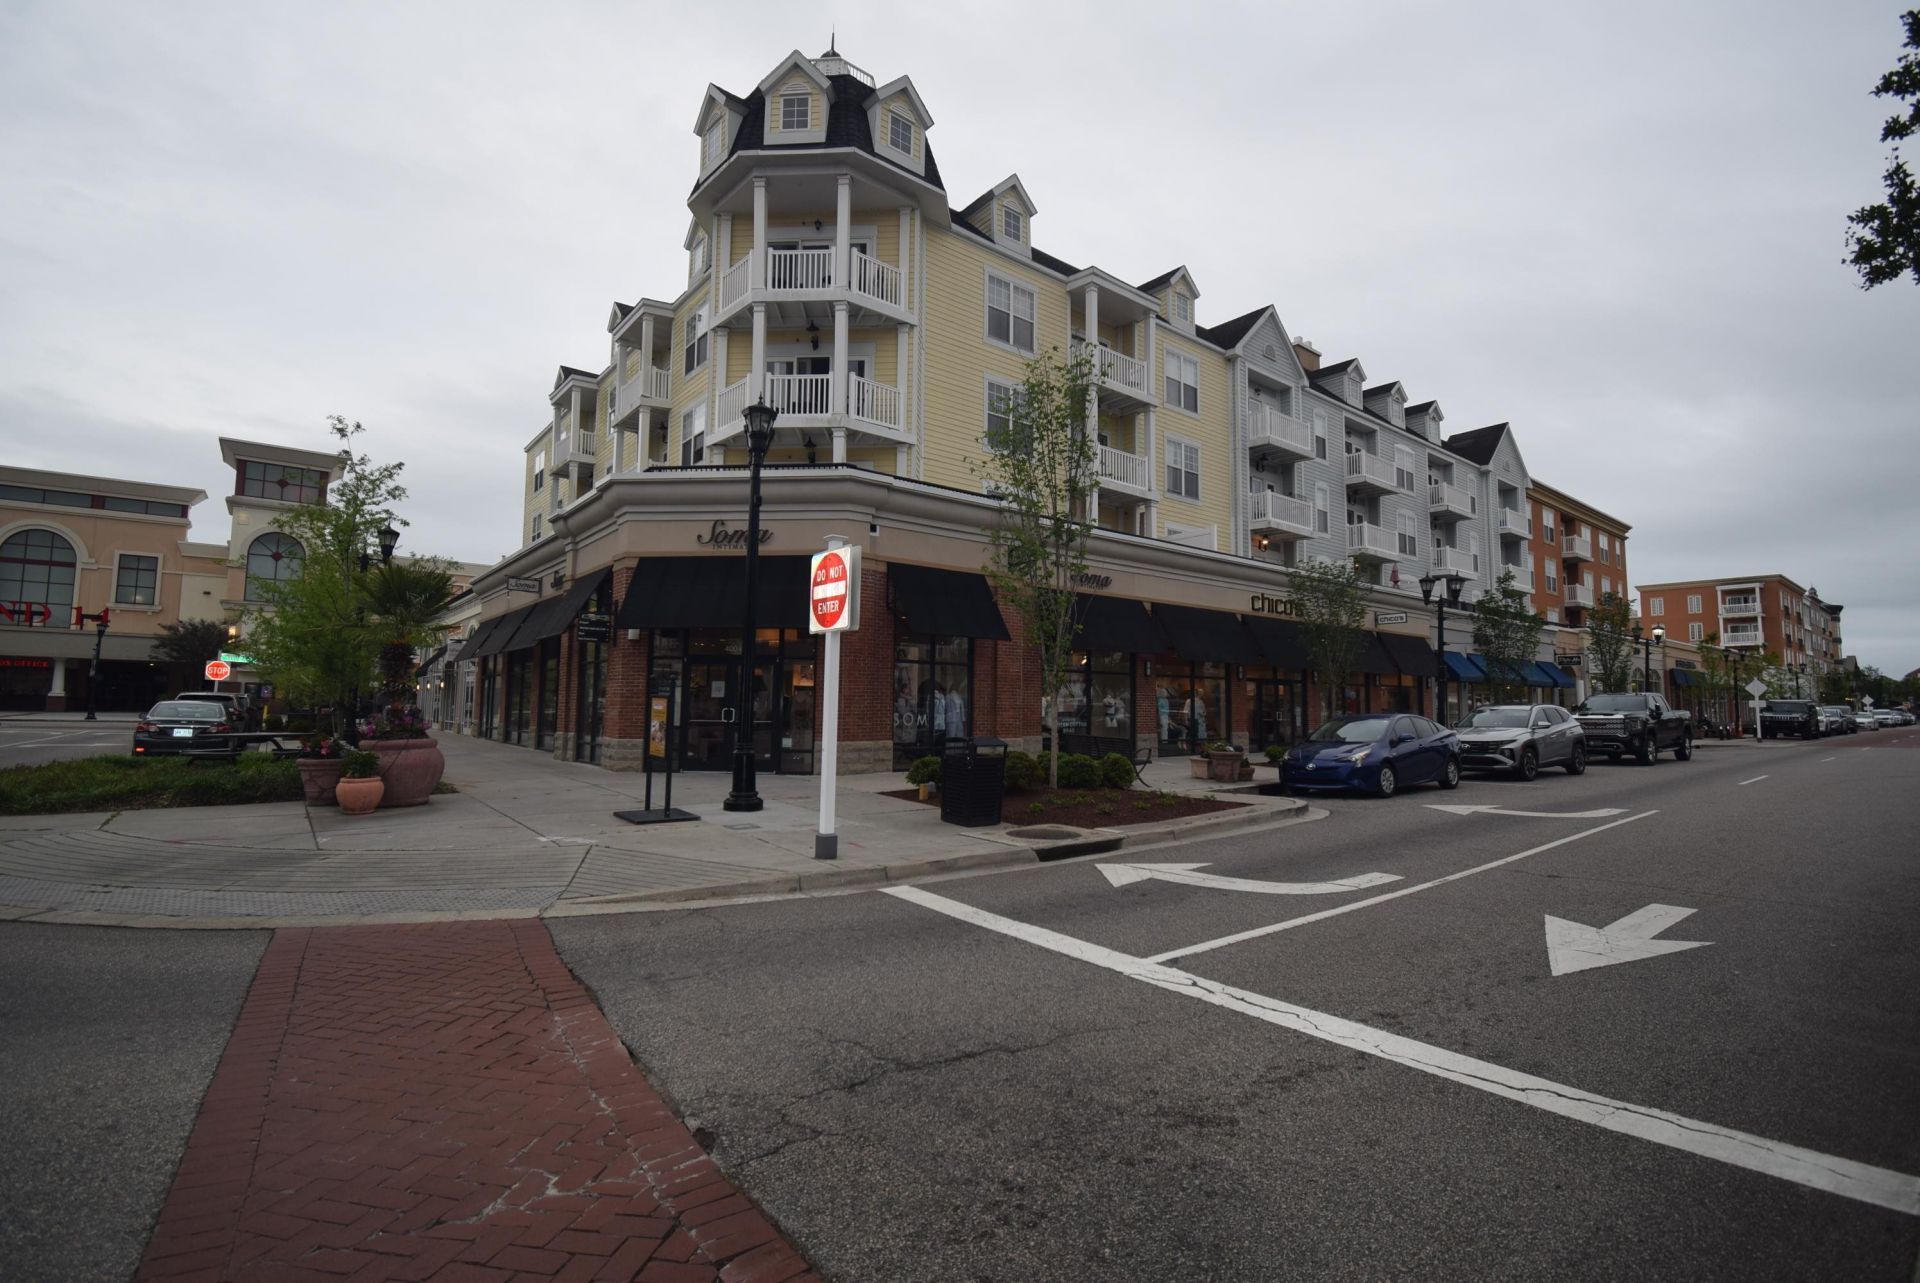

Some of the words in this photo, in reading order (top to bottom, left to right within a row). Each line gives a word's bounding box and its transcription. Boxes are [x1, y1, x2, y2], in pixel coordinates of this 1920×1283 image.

[817, 569, 826, 582] DO
[829, 565, 843, 579] NOT
[817, 600, 840, 614] ENTER
[207, 666, 228, 675] STOP
